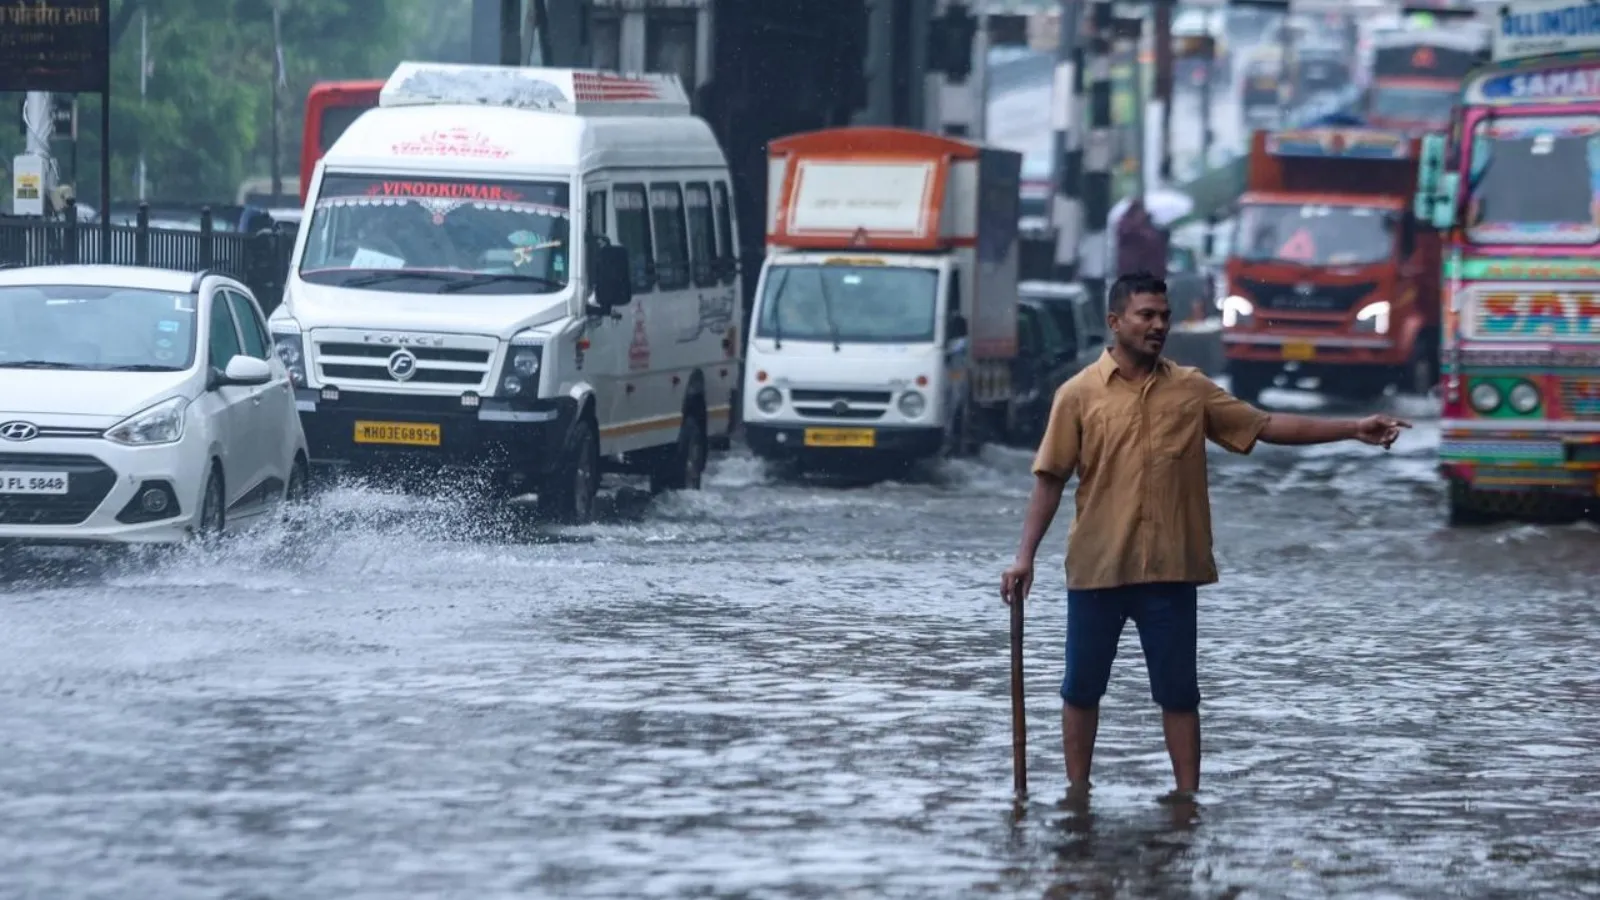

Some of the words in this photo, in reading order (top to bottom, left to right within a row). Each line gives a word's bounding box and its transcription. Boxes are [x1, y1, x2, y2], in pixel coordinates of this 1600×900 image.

[383, 182, 502, 199] VINODKUMAR
[363, 334, 444, 348] FORCE
[363, 425, 438, 441] MH03EG8956
[8, 477, 25, 490] FL
[29, 477, 65, 491] 5848
